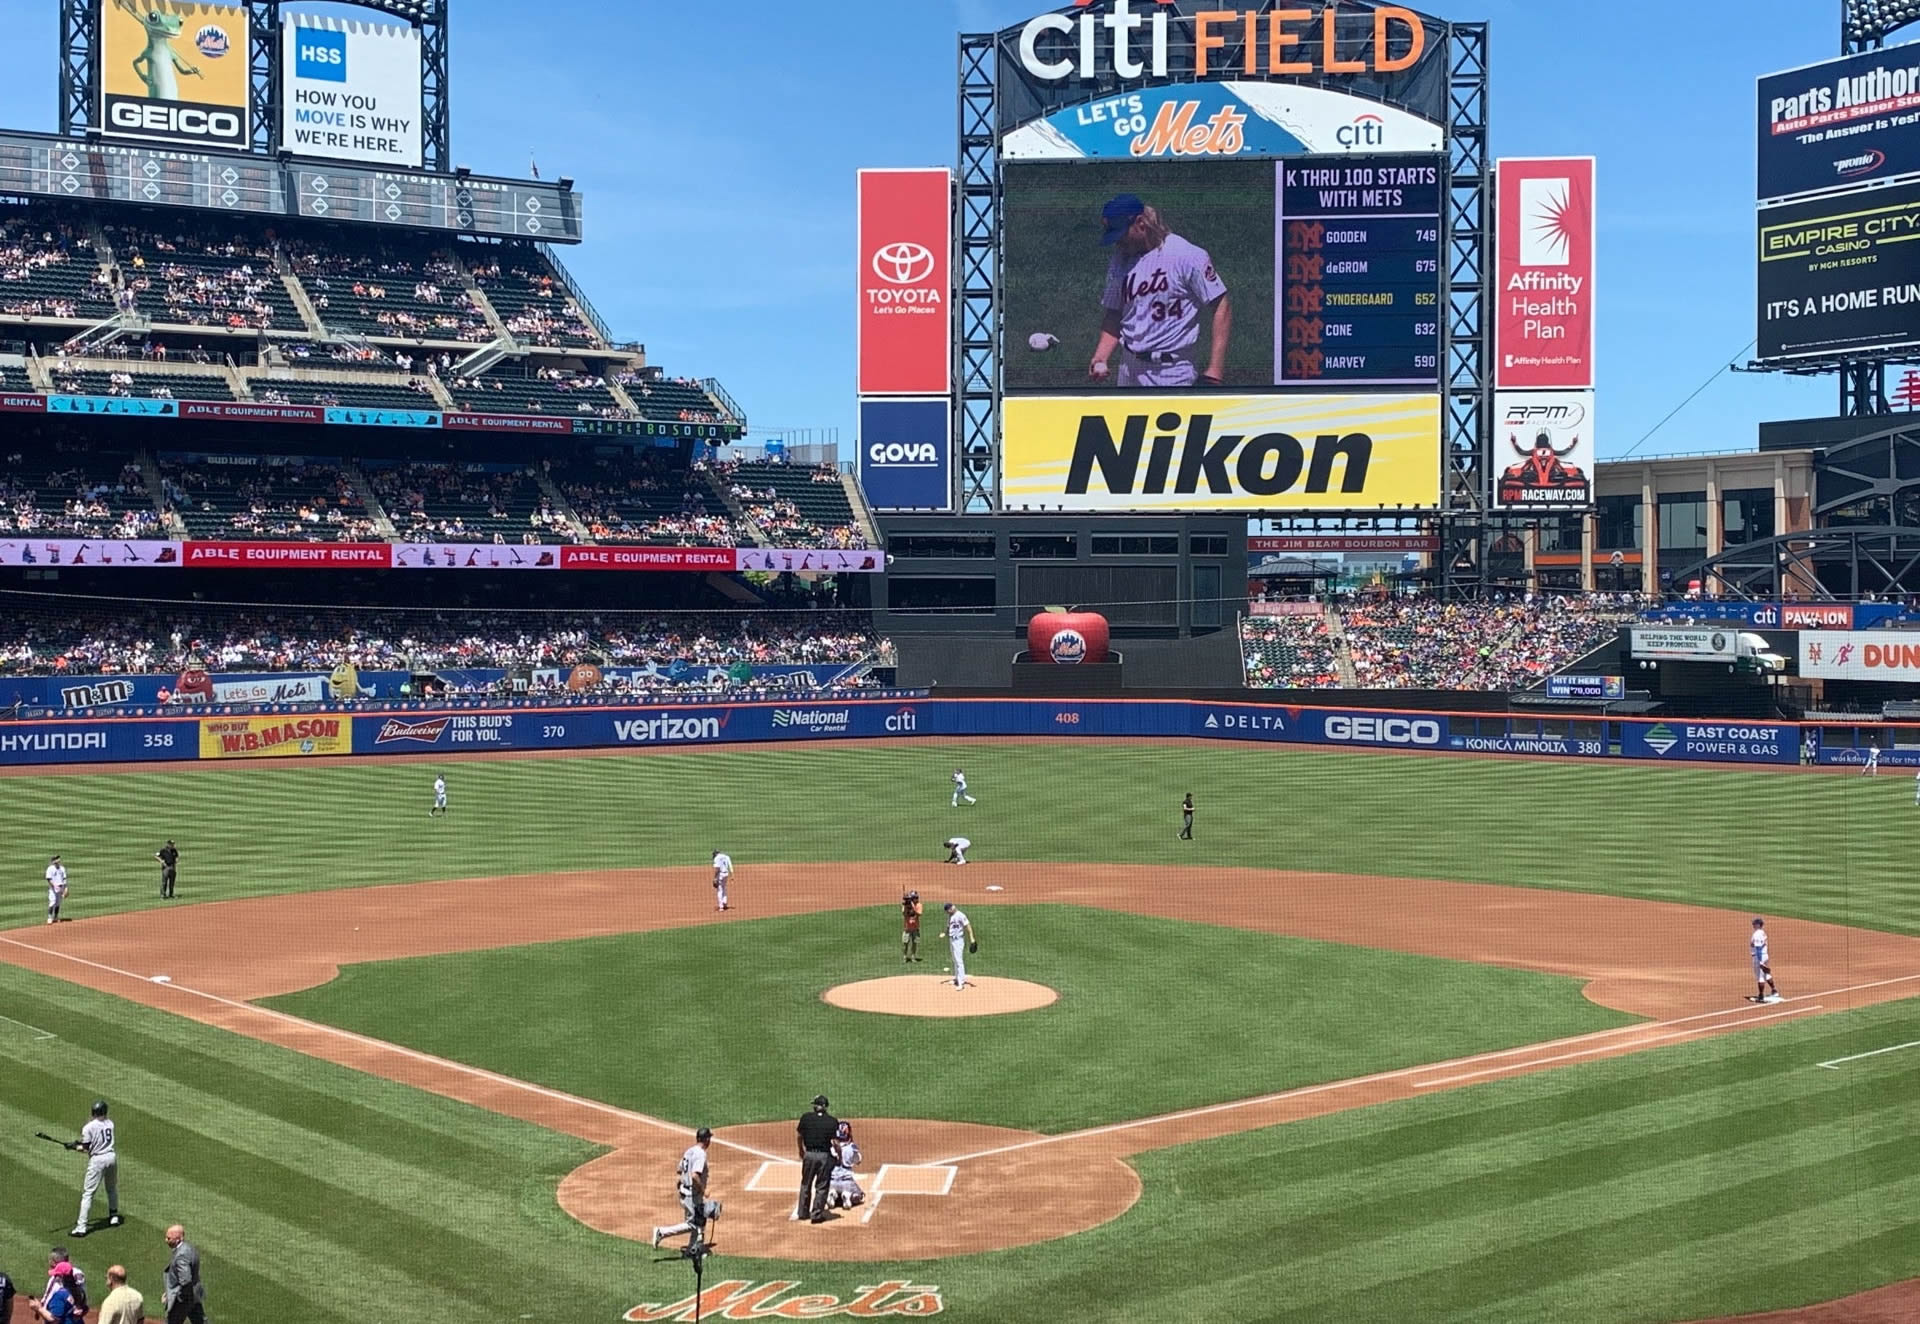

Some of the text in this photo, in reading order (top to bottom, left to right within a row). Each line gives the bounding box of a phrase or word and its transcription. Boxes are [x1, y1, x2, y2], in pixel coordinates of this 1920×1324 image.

[1019, 0, 1425, 79] citi FIELD
[302, 45, 341, 65] HSS
[296, 89, 376, 112] HOW YOU
[1771, 66, 1920, 123] Parts Author
[1077, 95, 1144, 126] LET'S
[1776, 119, 1808, 133] Auto
[1810, 109, 1848, 125] Parts
[1850, 101, 1894, 117] Super
[111, 102, 240, 137] GEICO
[295, 109, 411, 134] MOVE IS WHY
[1114, 114, 1149, 137] GO
[1130, 100, 1247, 156] Mets
[1336, 119, 1383, 146] citi
[1825, 121, 1874, 141] Answer
[1875, 119, 1889, 131] Is
[295, 129, 404, 154] WE'RE HERE.
[55, 141, 209, 163] AMERICAN LEAGUE
[376, 172, 509, 191] NATIONAL LEAGUE
[1286, 167, 1436, 187] K THRU 100 STARTS
[1319, 189, 1403, 208] WITH METS
[1326, 230, 1436, 244] GOODEN 749
[1770, 213, 1919, 250] EMPIRE CITY
[1815, 239, 1871, 256] CASINO
[1326, 260, 1436, 274] deGROM 675
[1808, 255, 1878, 272] BY MGM RESORTS
[1507, 272, 1583, 295] Affinity
[866, 288, 941, 303] TOYOTA
[1326, 292, 1436, 305] SYNDERGAARD 652
[1767, 283, 1920, 320] IT'S A HOME RUN
[873, 306, 936, 315] Let's Go Places
[1151, 299, 1185, 321] 34
[1513, 296, 1577, 317] Health
[1325, 323, 1436, 337] CONE 632
[1524, 319, 1565, 340] Plan
[1325, 356, 1436, 368] HARVEY 590
[1514, 356, 1583, 368] Affinity Health Plan
[3, 398, 43, 408] RENTAL
[225, 407, 279, 418] EQUIPMENT
[281, 410, 316, 419] RENTAL
[1506, 406, 1569, 419] RPM
[483, 418, 531, 428] EQUIPMENT
[532, 420, 565, 429] RENTAL
[647, 424, 655, 435] B
[672, 424, 680, 436] S
[870, 443, 936, 463] GOYA
[1064, 411, 1374, 496] Nikon
[1503, 488, 1586, 501] RPMRACEWAY.COM
[1255, 540, 1429, 549] THE JIM BEAM BOURBON BAR
[191, 547, 384, 561] ABLE EQUIPMENT RENTAL
[568, 551, 730, 564] ABLE EQUIPMENT RENTAL
[1754, 607, 1777, 625] citi
[1863, 644, 1920, 668] DUN
[1552, 676, 1601, 685] HIT IT HERE
[224, 688, 250, 701] Let's
[252, 687, 267, 699] Go
[1551, 686, 1570, 695] WIN
[452, 715, 513, 729] THIS BUD'S
[789, 709, 848, 725] National
[885, 711, 916, 731] citi
[1056, 712, 1080, 724] 408
[1224, 715, 1285, 731] DELTA
[207, 722, 250, 734] WHO BUT
[384, 724, 442, 738] Budweiser
[543, 726, 565, 738] 370
[614, 713, 719, 741] verizon
[810, 723, 847, 733] Car Rental
[1325, 716, 1440, 744] GEICO
[1686, 727, 1779, 741] EAST COAST
[1, 732, 106, 752] HYUNDAI
[144, 734, 173, 747] 358
[452, 730, 501, 742] FOR YOU.
[1466, 738, 1568, 754] KONICA MINOLTA
[1578, 741, 1601, 754] 380
[1687, 742, 1779, 756] POWER & GAS
[1831, 755, 1867, 764] workday
[623, 1280, 943, 1321] Mets
